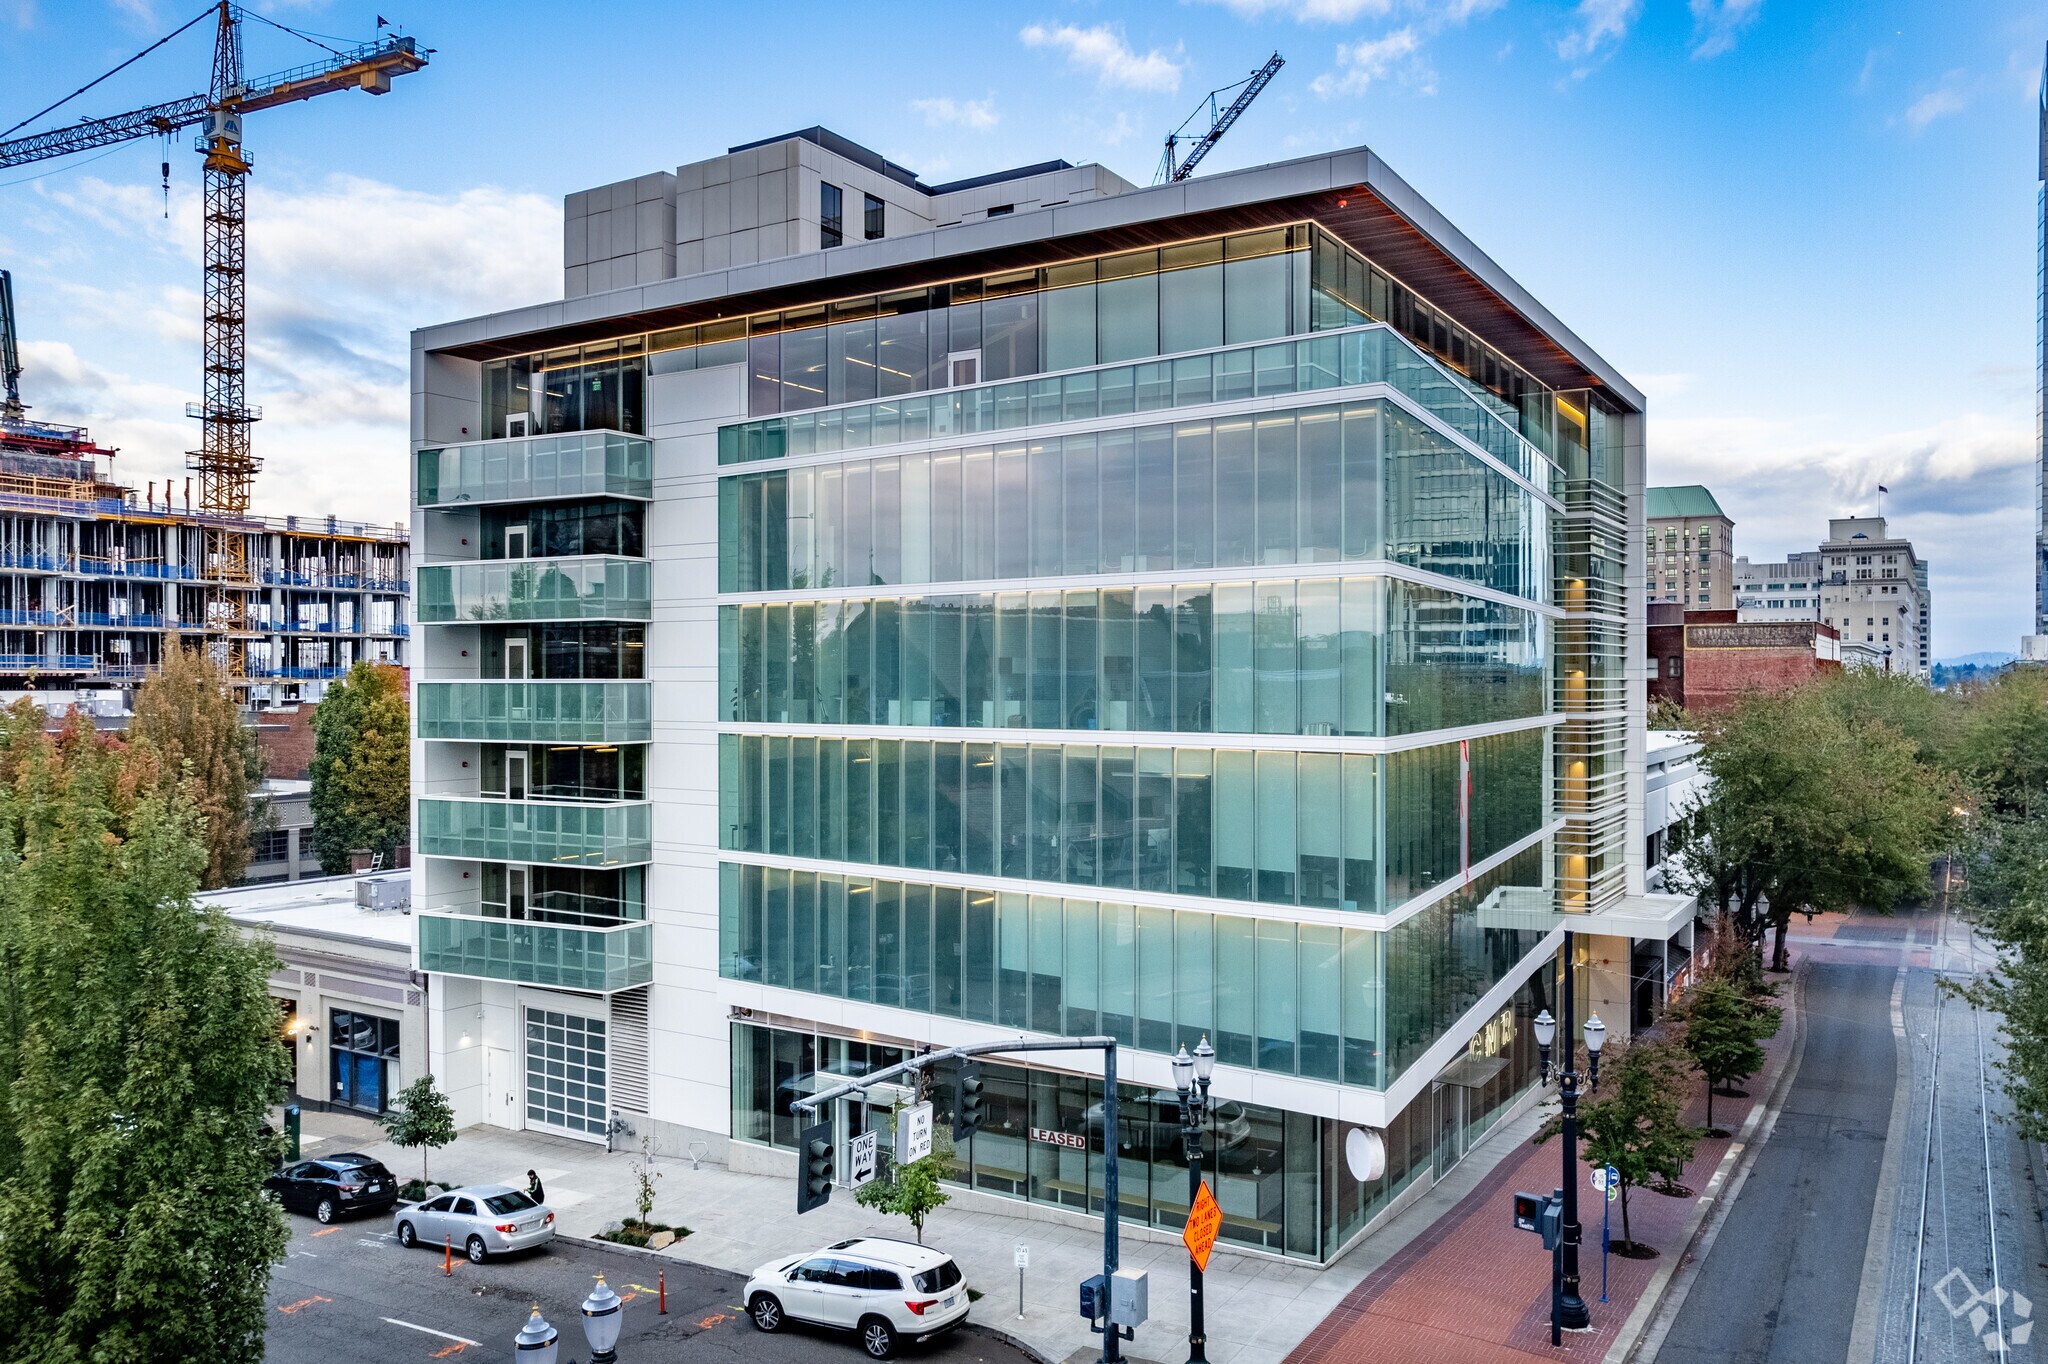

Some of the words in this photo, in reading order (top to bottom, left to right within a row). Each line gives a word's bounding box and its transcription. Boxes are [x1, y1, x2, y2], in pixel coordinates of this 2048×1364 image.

[917, 1115, 925, 1126] NO
[913, 1127, 928, 1141] TURN
[1031, 1128, 1085, 1148] LEASED
[856, 1136, 873, 1153] ONE
[909, 1146, 917, 1157] ON
[920, 1140, 930, 1151] RED
[855, 1149, 873, 1167] WAY
[1196, 1196, 1210, 1212] RIGHT
[1189, 1216, 1199, 1230] TWO
[1201, 1206, 1217, 1224] LANES
[1194, 1223, 1212, 1242] CLOSED
[1196, 1238, 1211, 1253] AHEAD
